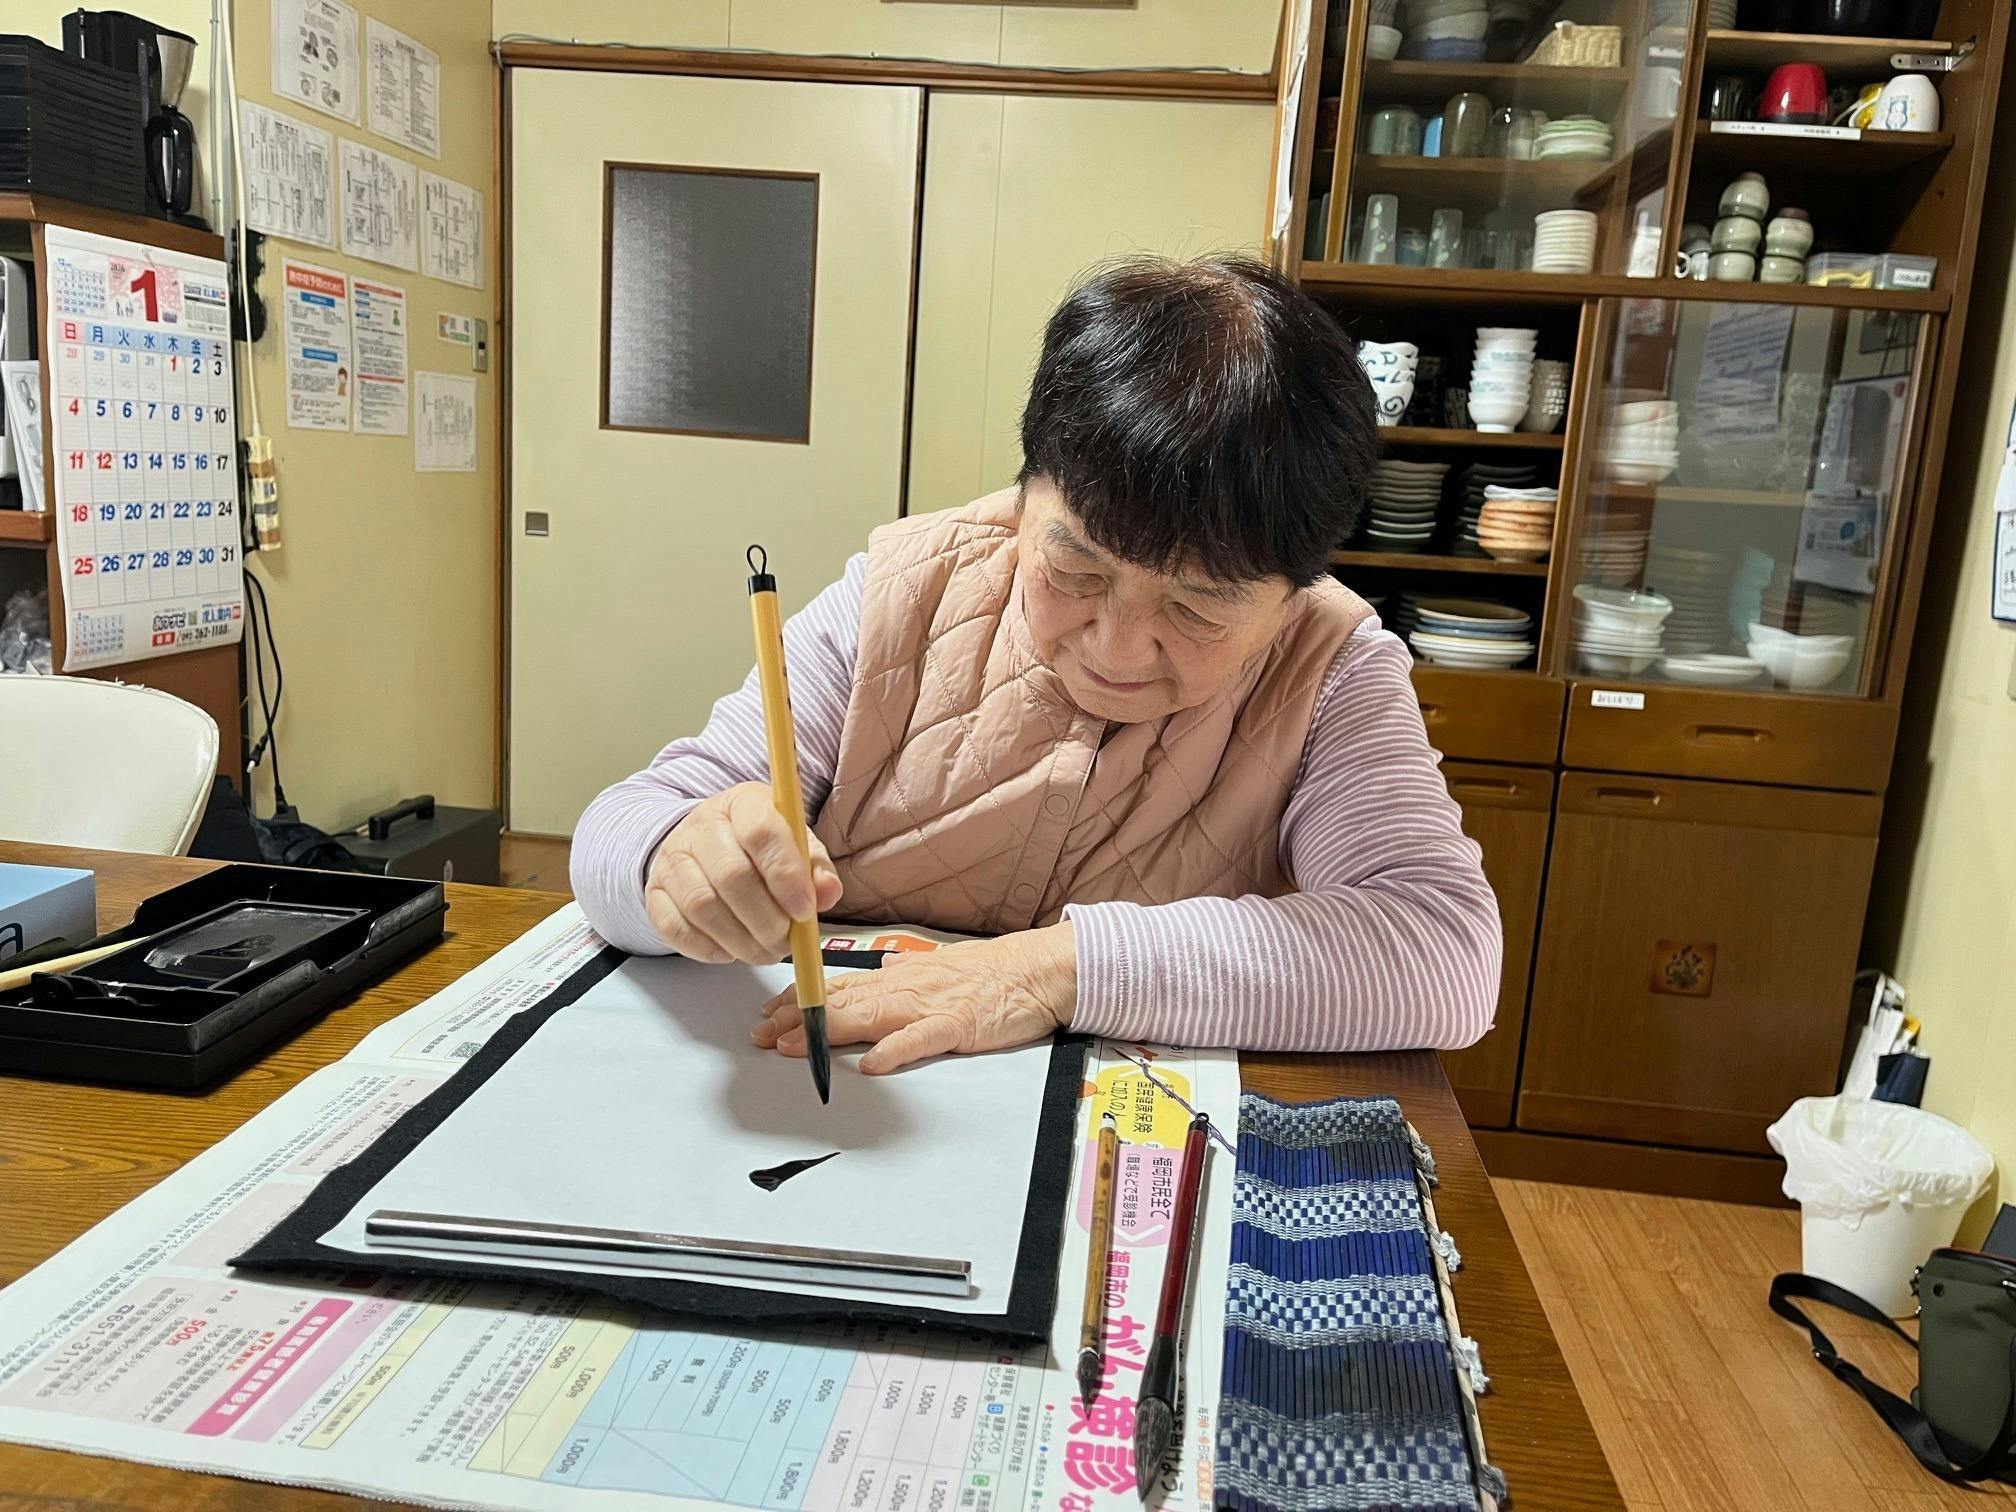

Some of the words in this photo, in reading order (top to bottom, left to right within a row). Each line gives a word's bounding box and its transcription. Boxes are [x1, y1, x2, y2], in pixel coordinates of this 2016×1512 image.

[131, 270, 159, 322] 1
[65, 323, 76, 340] 日
[93, 326, 103, 343] 月
[118, 330, 130, 346] 火
[144, 334, 155, 349] 水
[168, 336, 178, 351] 木
[191, 340, 202, 355] 金
[213, 342, 222, 358] 土
[171, 356, 177, 372] 1
[192, 359, 201, 374] 2
[214, 361, 222, 376] 3
[69, 399, 79, 416] 4
[96, 400, 106, 417] 5
[122, 402, 132, 418] 6
[148, 404, 156, 419] 7
[171, 405, 180, 421] 8
[194, 407, 203, 422] 9
[214, 408, 226, 423] 10
[69, 452, 84, 469] 11
[97, 453, 112, 469] 12
[123, 453, 138, 470] 13
[148, 453, 162, 469] 14
[172, 454, 186, 470] 15
[195, 454, 208, 470] 16
[216, 455, 228, 470] 17
[71, 505, 88, 522] 18
[100, 504, 115, 520] 19
[124, 504, 142, 520] 20
[150, 503, 165, 519] 21
[173, 503, 190, 518] 22
[196, 502, 211, 517] 23
[218, 501, 232, 516] 24
[74, 558, 93, 575] 25
[101, 556, 120, 573] 26
[128, 554, 145, 571] 27
[152, 552, 169, 568] 28
[176, 550, 193, 566] 29
[199, 549, 214, 564] 30
[221, 547, 234, 562] 31
[1134, 1082, 1154, 1133] 国民健康保険
[1150, 1157, 1173, 1220] 福岡市民全て
